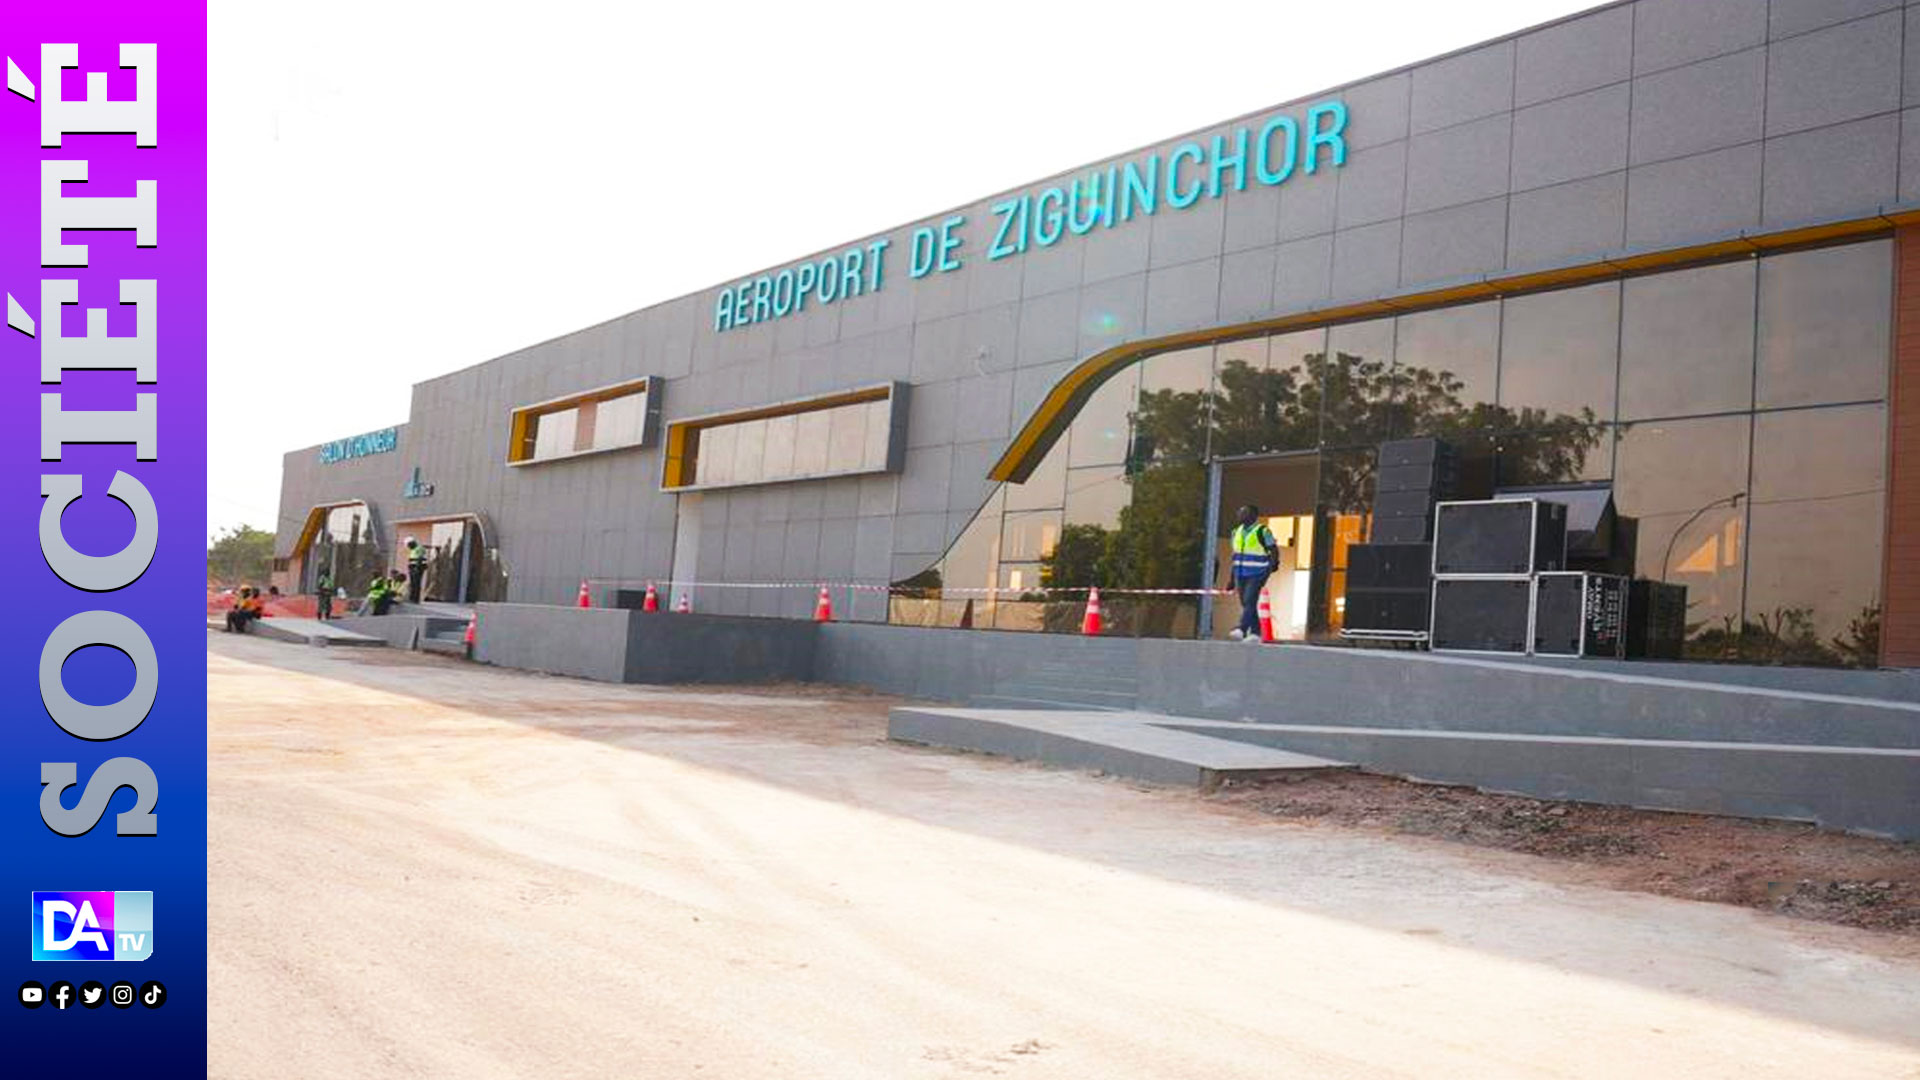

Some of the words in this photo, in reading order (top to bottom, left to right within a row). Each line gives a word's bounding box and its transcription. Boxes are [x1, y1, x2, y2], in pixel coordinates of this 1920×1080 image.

[715, 240, 891, 332] AEROPORT
[909, 216, 965, 279] DE
[989, 100, 1350, 261] ZIGUINCHOR
